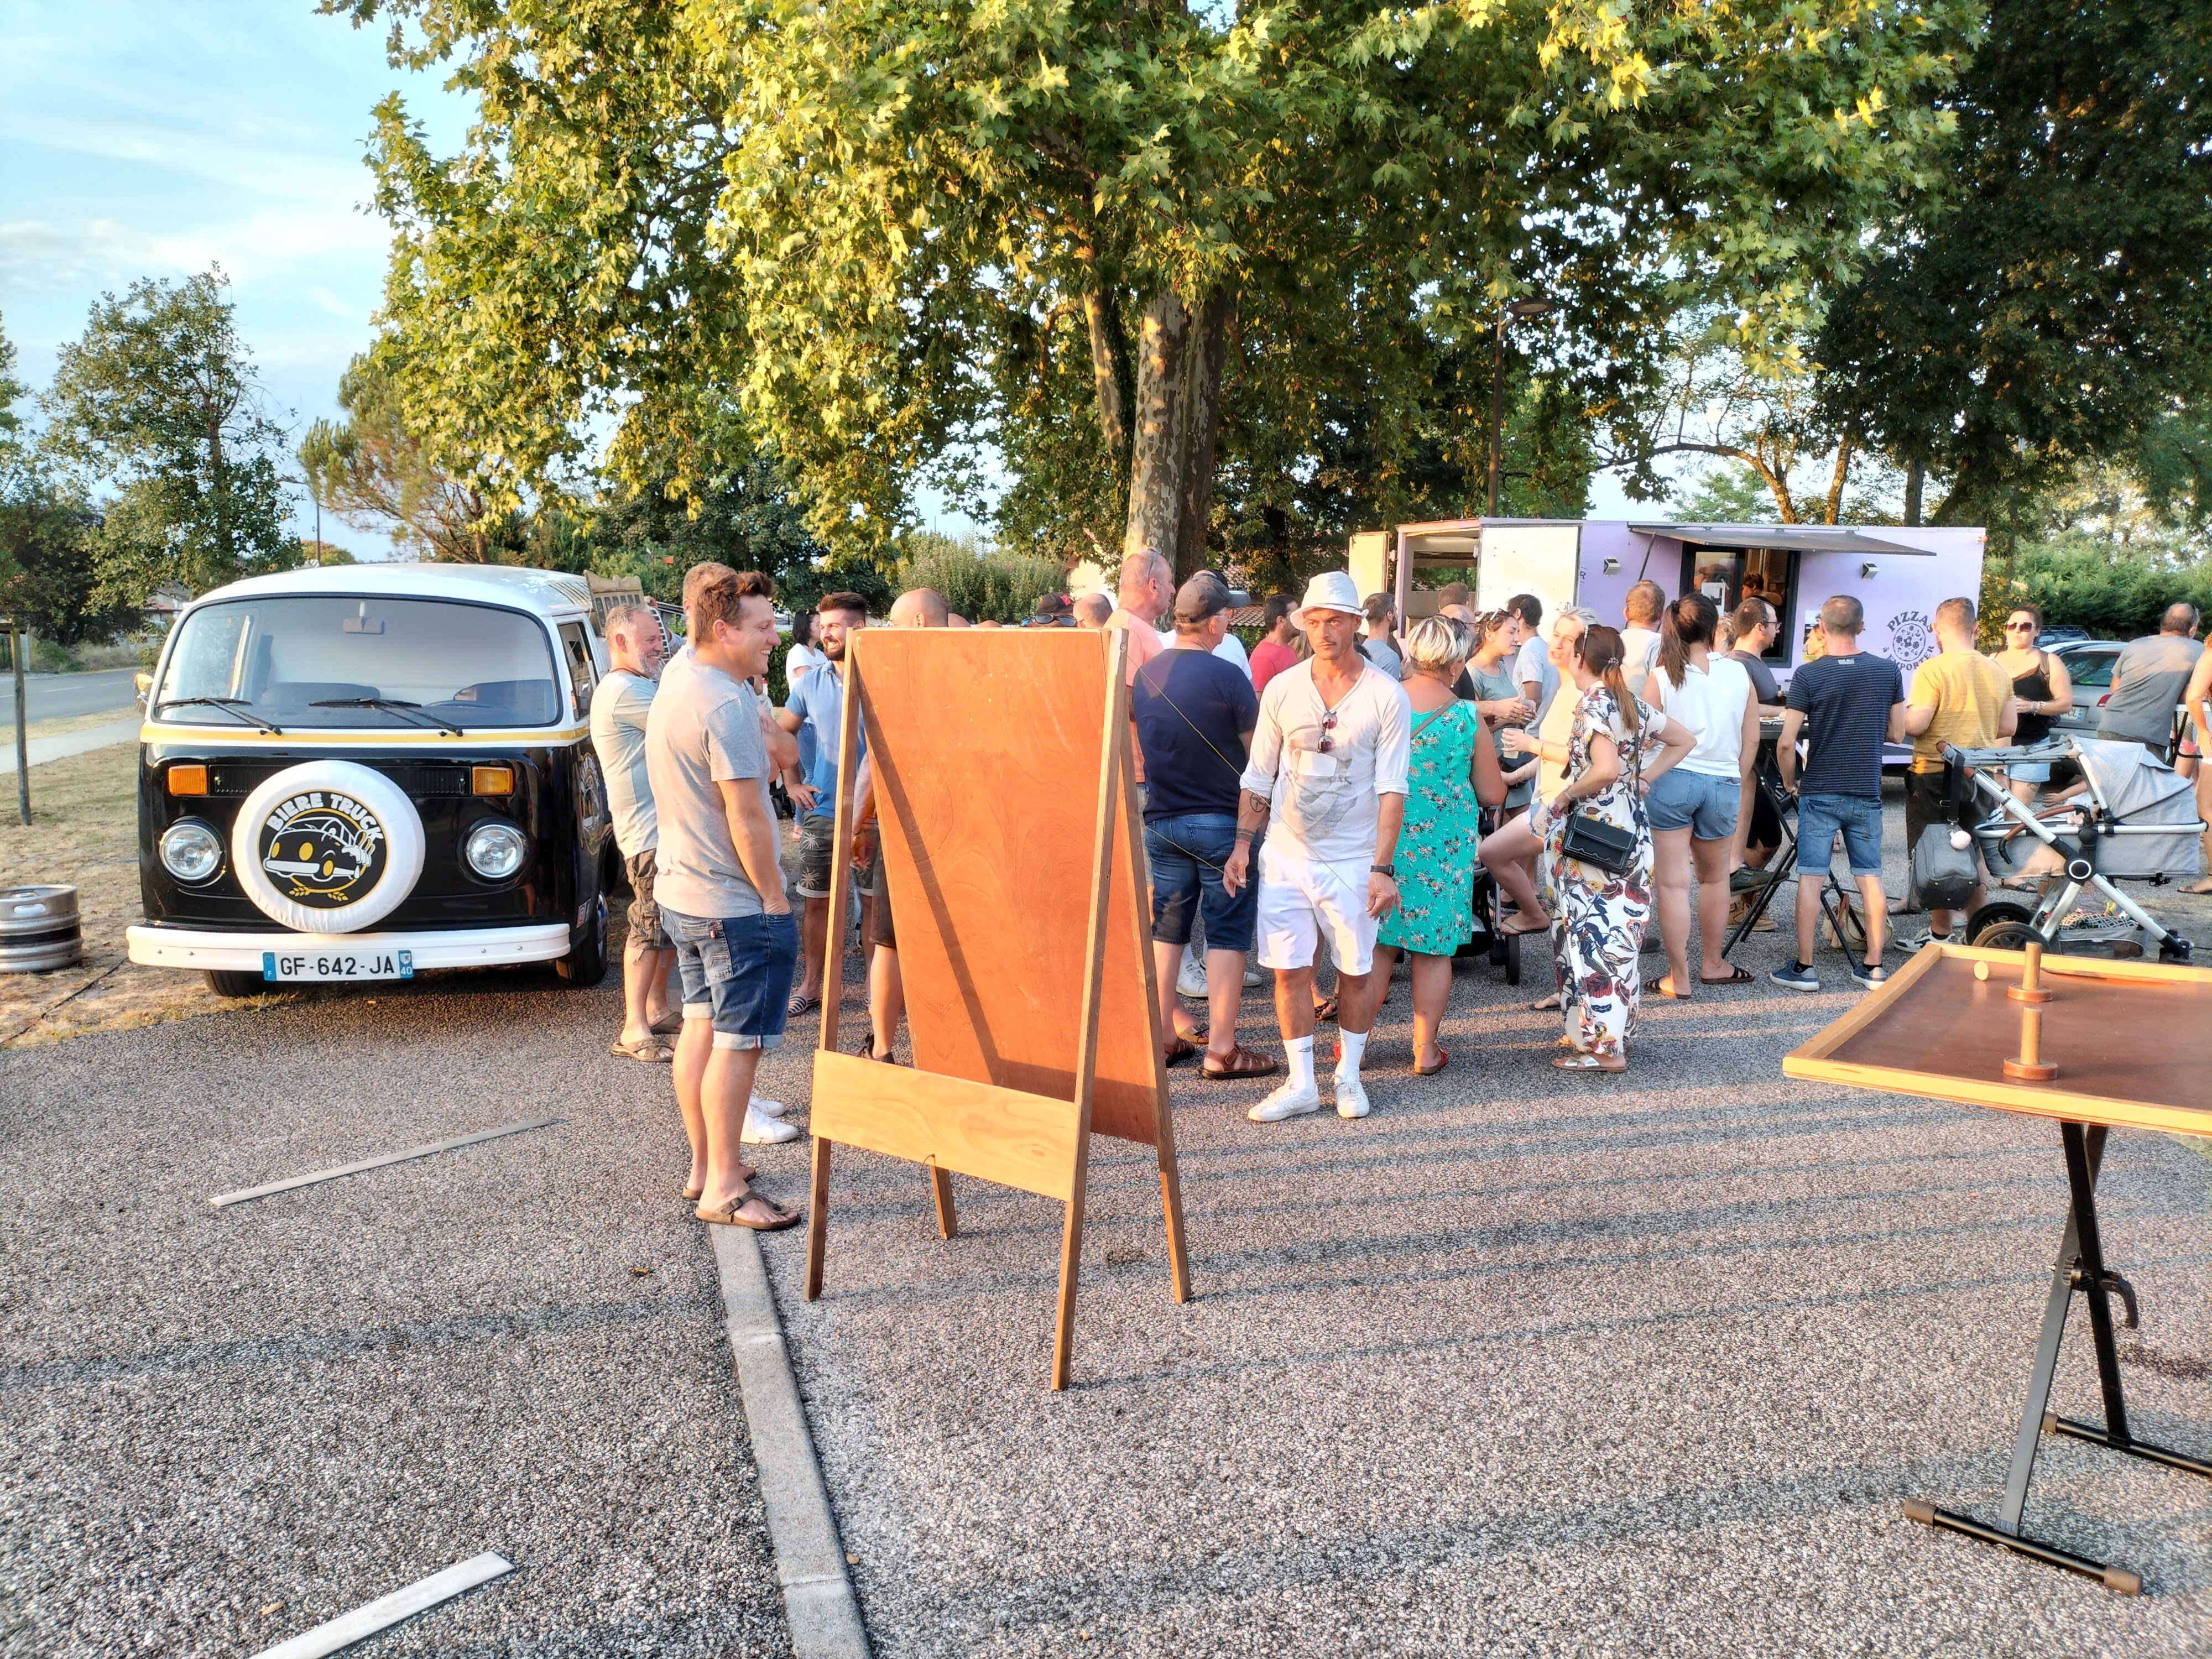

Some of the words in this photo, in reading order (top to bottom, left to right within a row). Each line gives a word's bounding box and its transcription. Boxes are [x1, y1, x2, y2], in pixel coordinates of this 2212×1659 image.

[1886, 611, 1933, 633] PIZZAS
[266, 792, 324, 831] BIERE
[330, 794, 384, 839] TRUCK
[280, 956, 395, 975] GF-642-JA
[400, 966, 412, 975] 40
